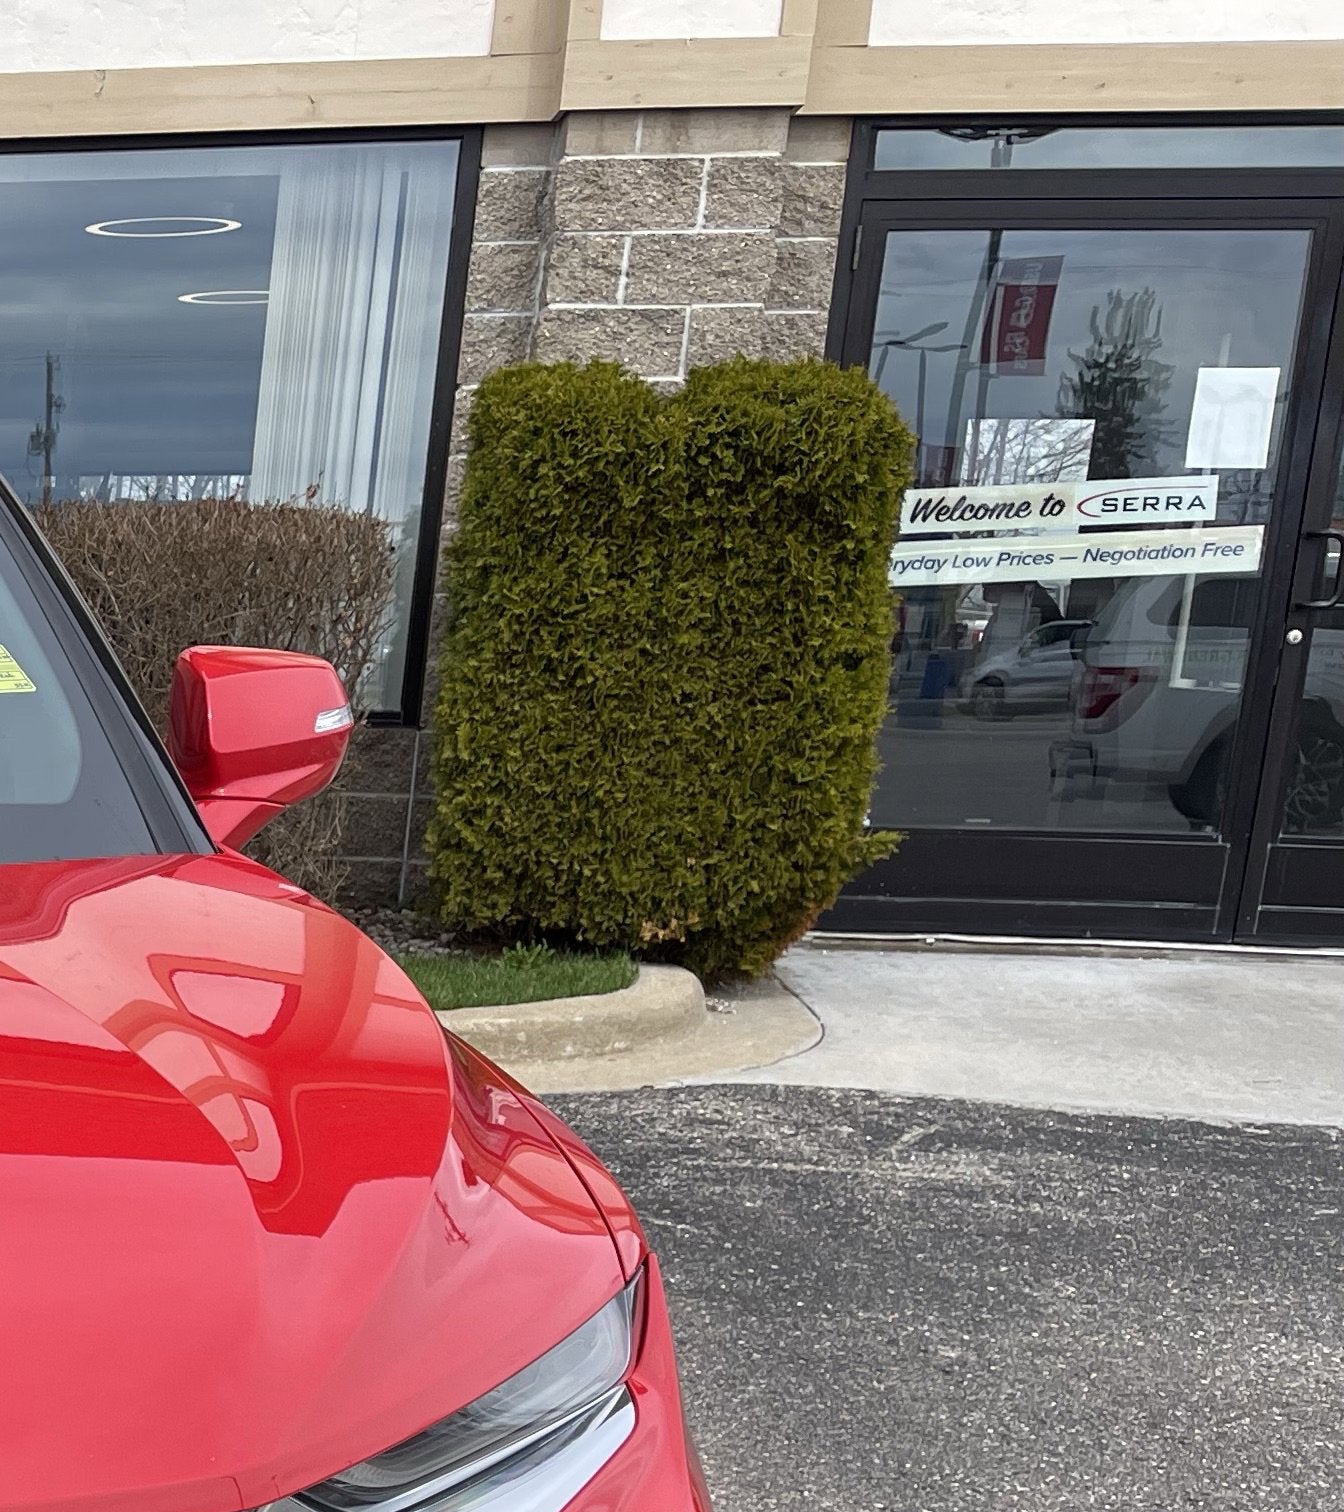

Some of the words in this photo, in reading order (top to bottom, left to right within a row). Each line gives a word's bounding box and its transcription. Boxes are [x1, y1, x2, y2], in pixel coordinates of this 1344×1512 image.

[910, 495, 1032, 523] Welcome
[1039, 493, 1066, 518] to
[1100, 495, 1207, 513] SERRA
[952, 553, 992, 569] Low
[996, 551, 1055, 567] Prices
[1083, 545, 1196, 565] Negotiation
[1201, 542, 1245, 558] Free
